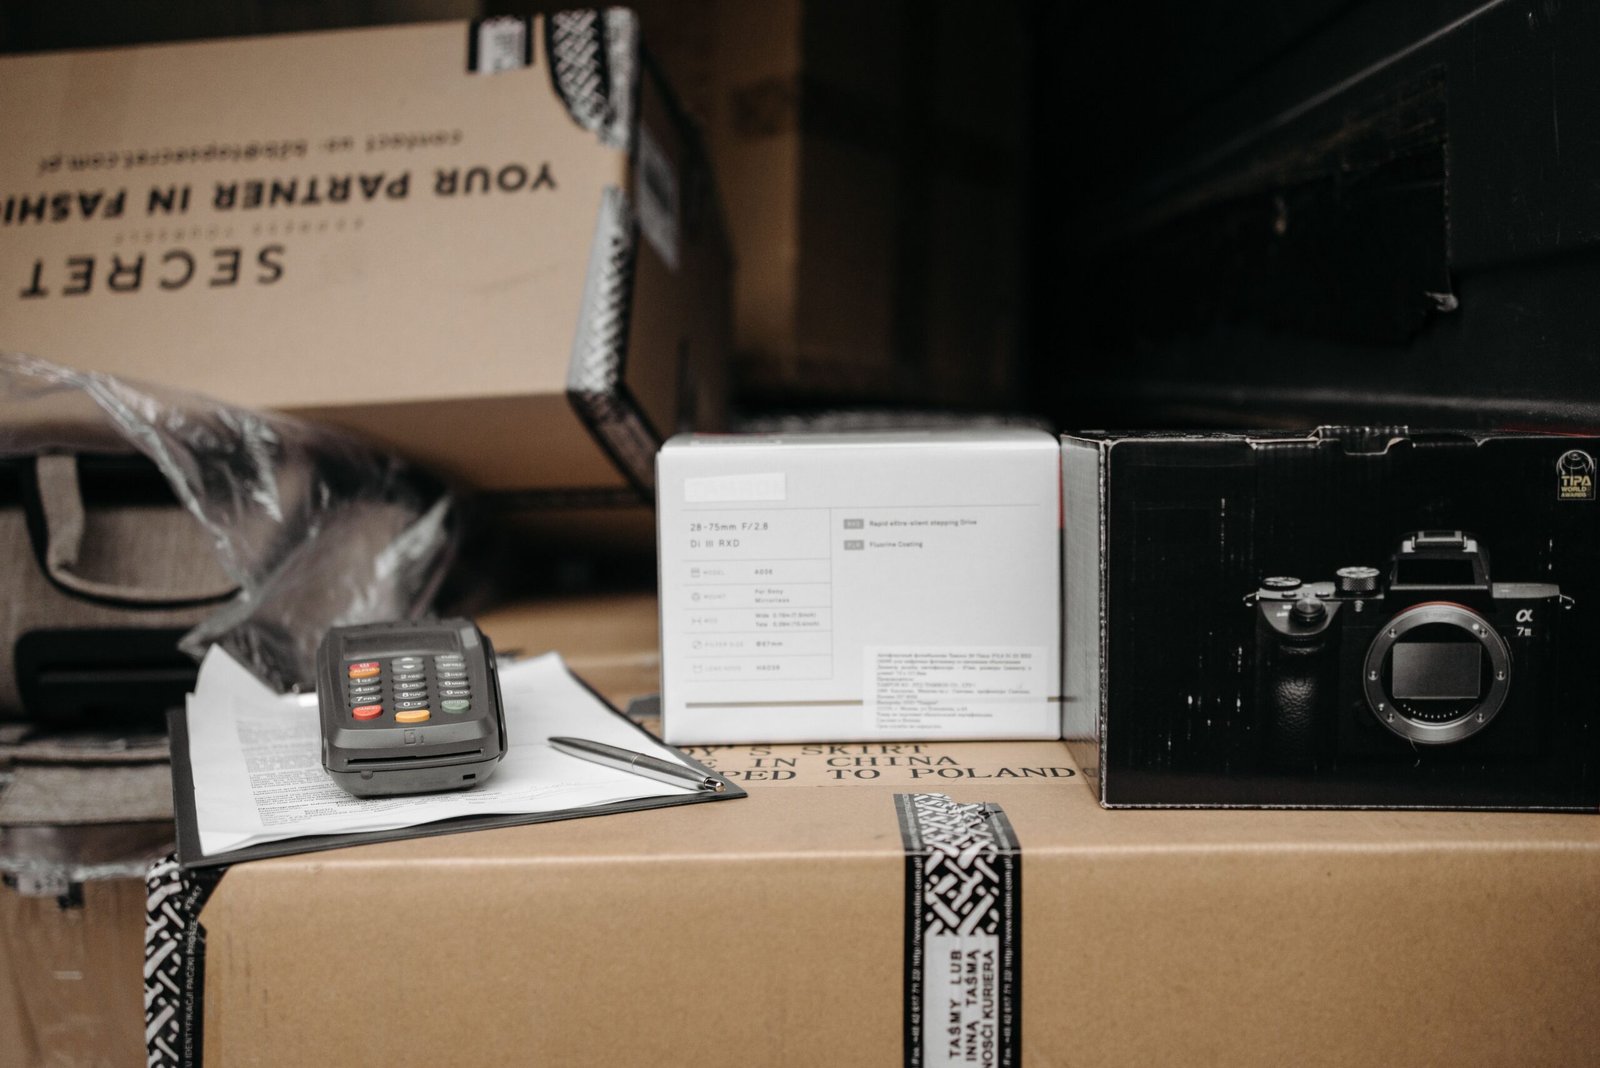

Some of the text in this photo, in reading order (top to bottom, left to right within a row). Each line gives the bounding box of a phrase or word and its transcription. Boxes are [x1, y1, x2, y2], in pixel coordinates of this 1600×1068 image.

[0, 162, 558, 226] YOUR PARTNER IN FASHI
[20, 245, 286, 299] SECRET
[1561, 475, 1592, 486] TIPA
[690, 522, 769, 532] 28-75mm F/2.8
[690, 539, 701, 548] Di
[719, 539, 740, 548] RXD
[898, 541, 923, 549] Coating
[801, 744, 928, 756] SKIRT
[753, 756, 960, 768] IN CHINA
[826, 768, 881, 780] TO
[910, 767, 1076, 779] POLAND
[186, 957, 195, 990] PACZKI
[982, 950, 994, 1019] KURIERA
[947, 950, 962, 1059] TAŚMY LUB
